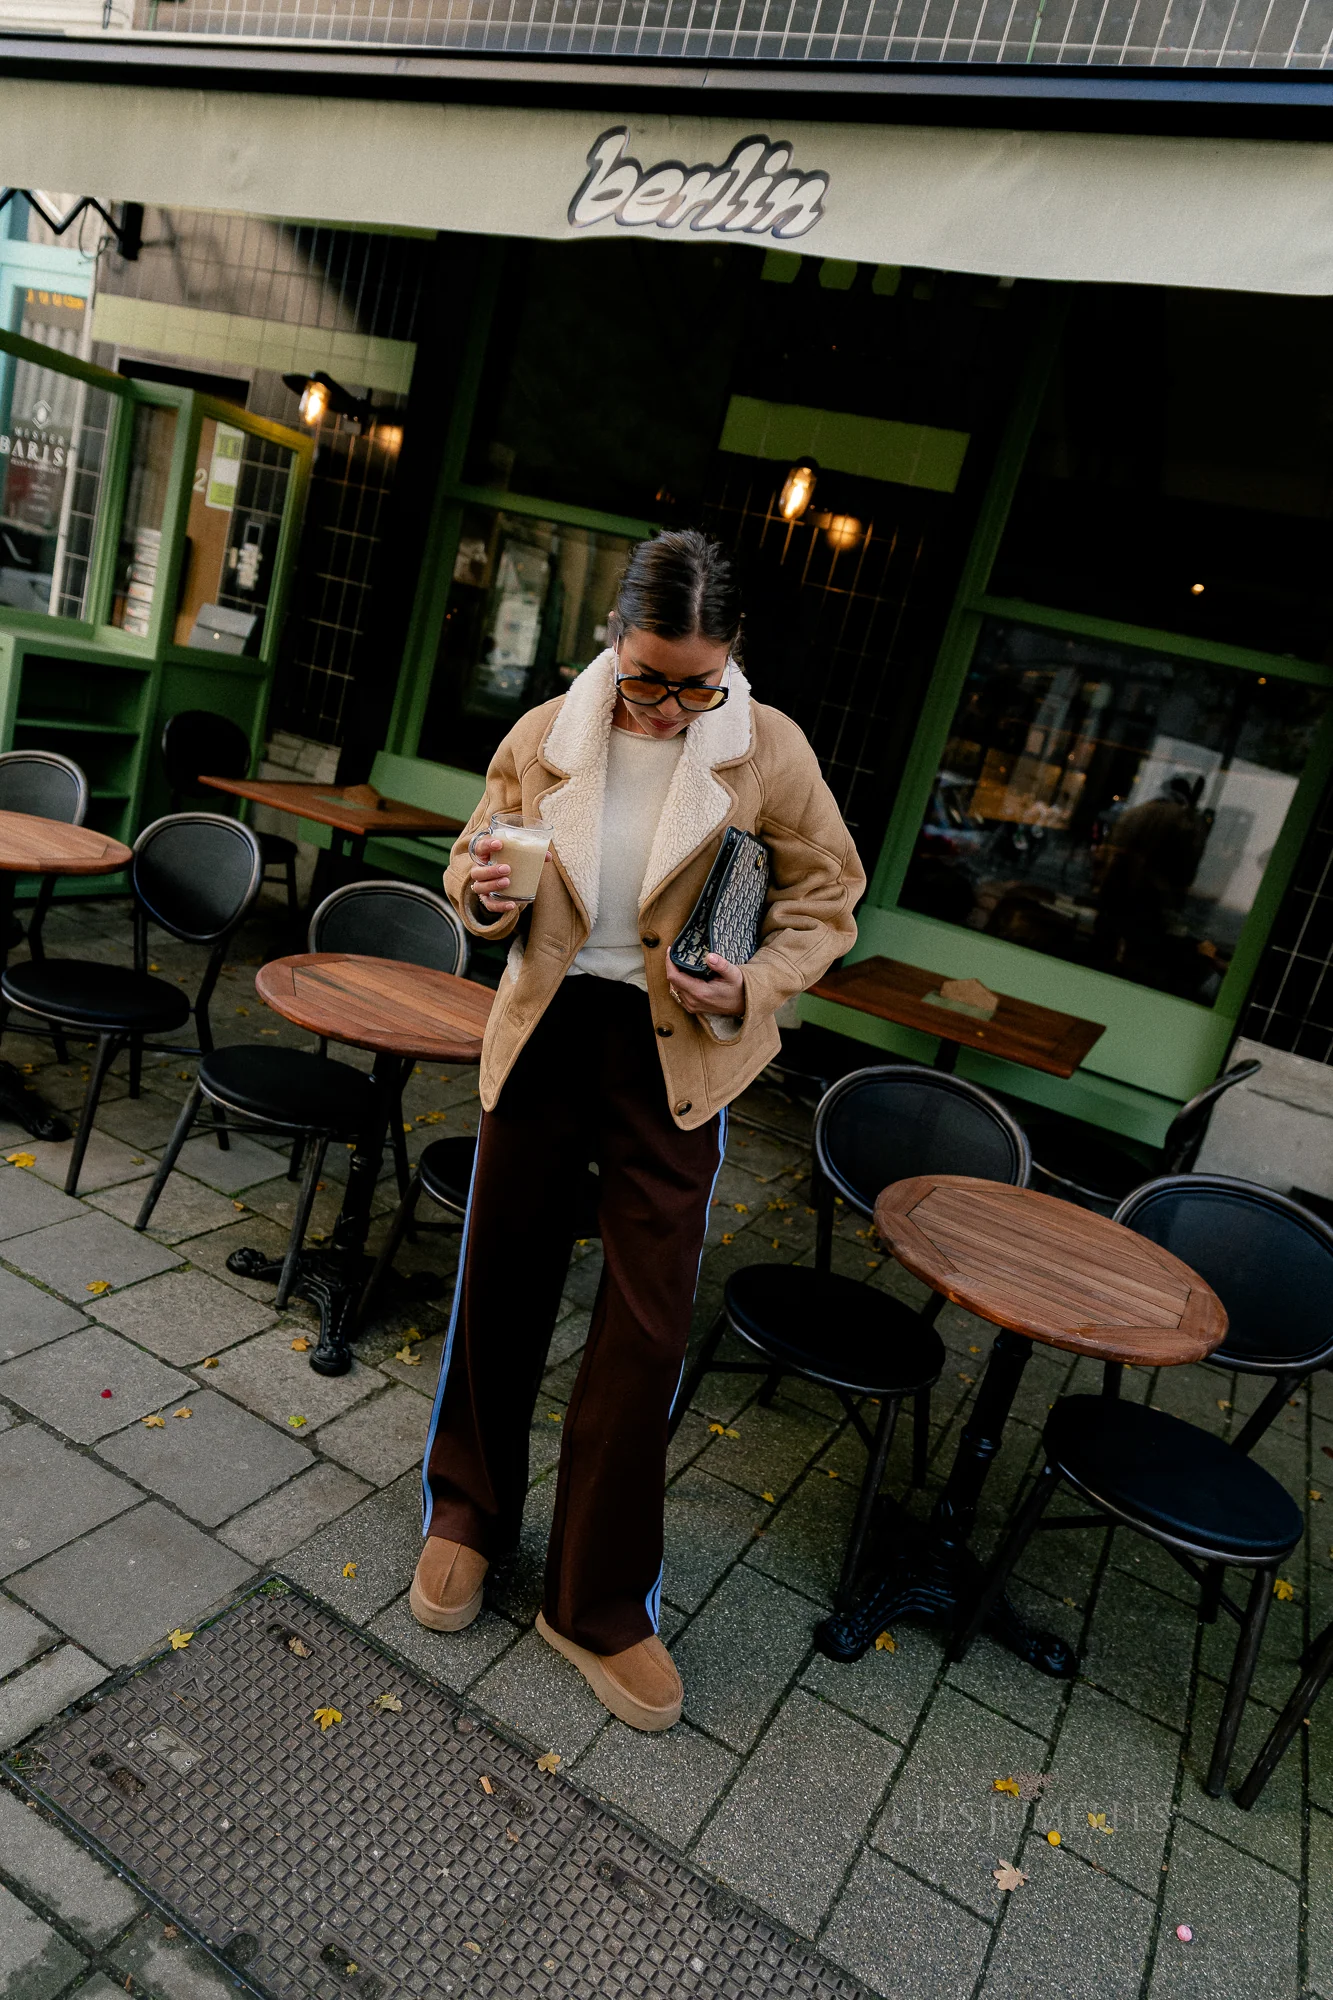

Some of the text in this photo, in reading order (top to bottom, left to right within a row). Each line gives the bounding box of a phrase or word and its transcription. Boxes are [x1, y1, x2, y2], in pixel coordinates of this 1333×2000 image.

[567, 125, 830, 238] berlin
[0, 435, 68, 468] BARIS
[193, 467, 208, 492] 2
